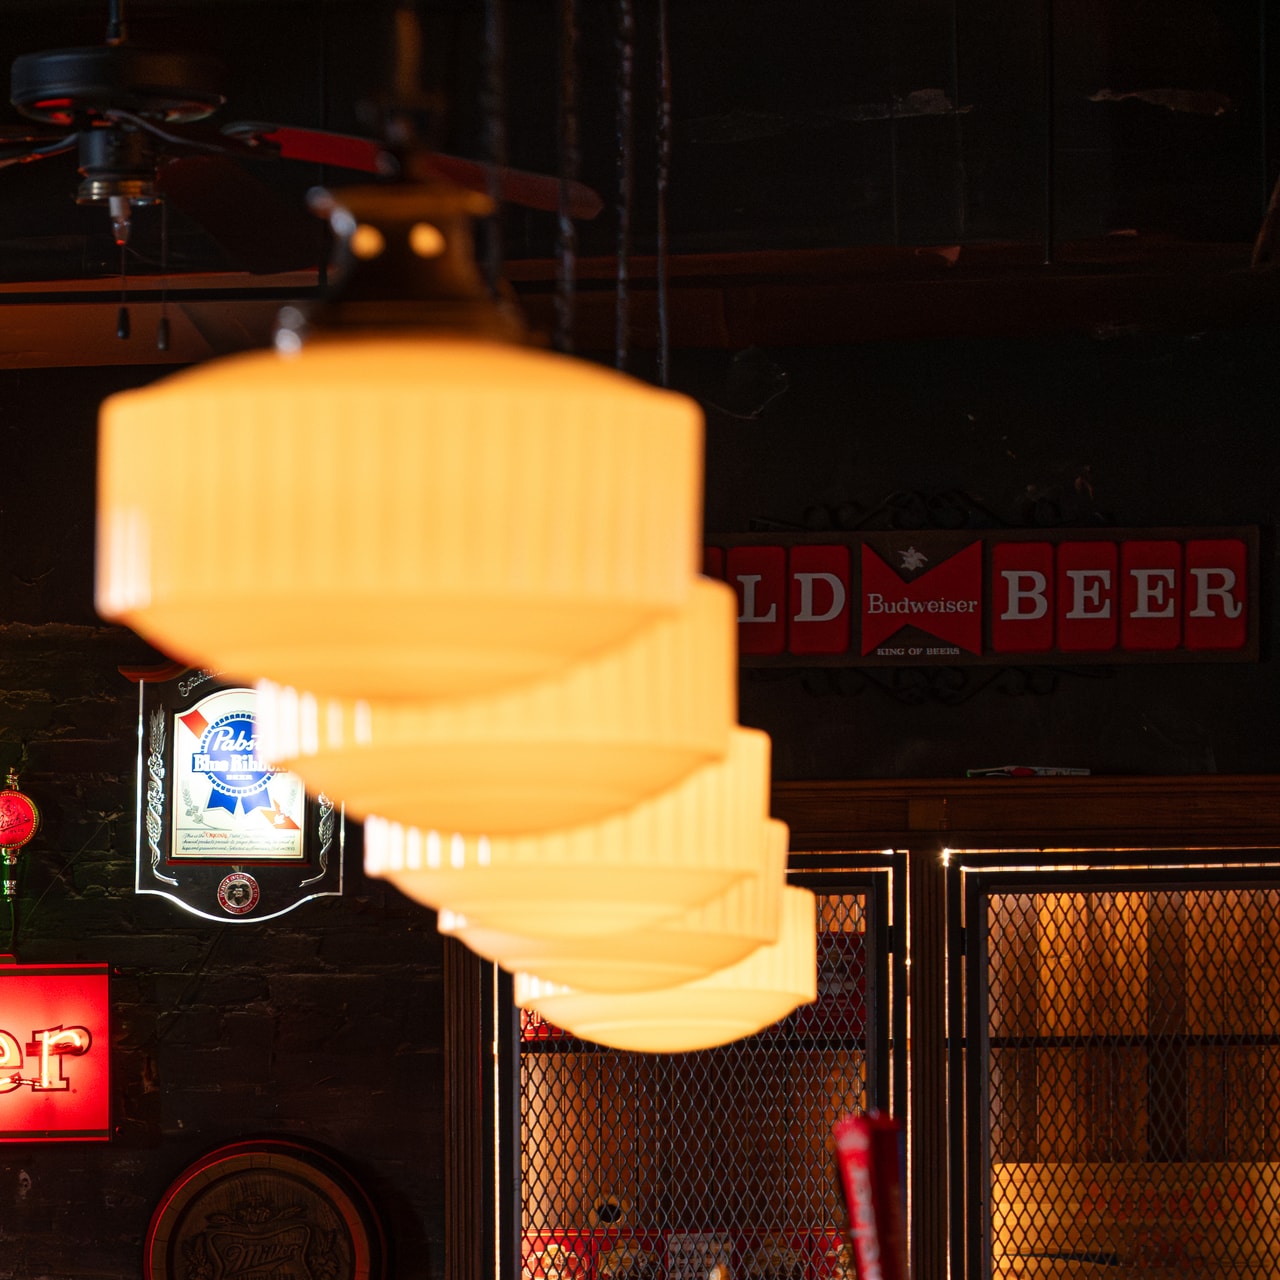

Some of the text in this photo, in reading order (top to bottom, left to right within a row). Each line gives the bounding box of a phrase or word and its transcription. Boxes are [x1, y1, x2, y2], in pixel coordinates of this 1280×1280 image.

[736, 567, 1242, 624] LD BEER
[867, 594, 979, 615] Budweiser
[877, 648, 905, 656] KING
[926, 647, 960, 655] BEERS
[193, 754, 229, 772] Blue
